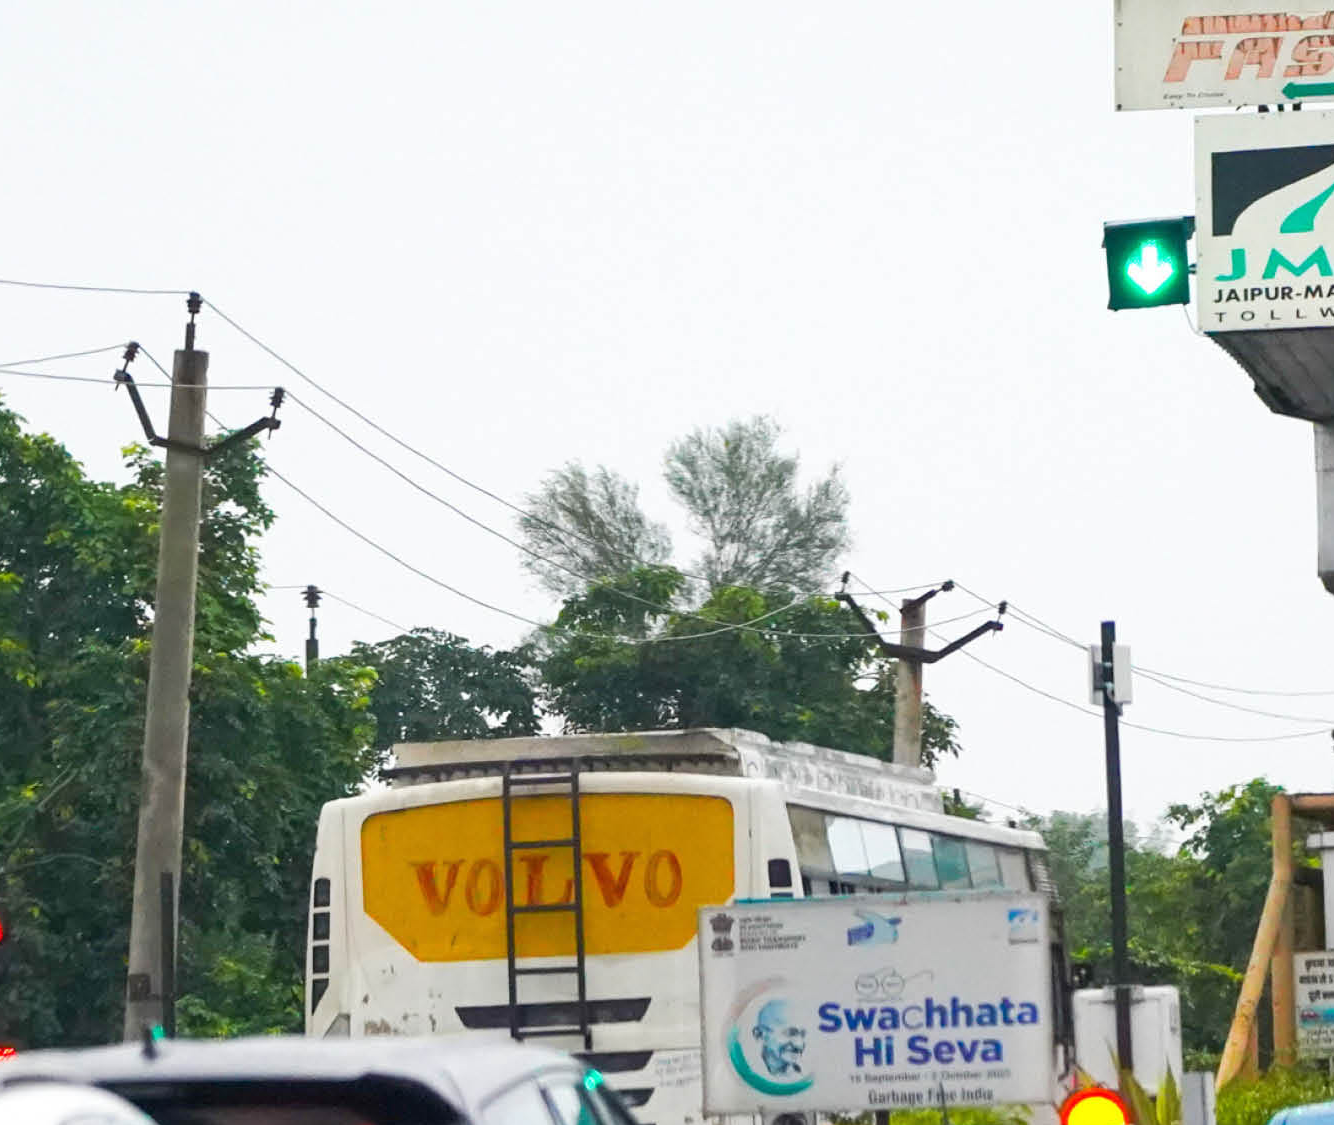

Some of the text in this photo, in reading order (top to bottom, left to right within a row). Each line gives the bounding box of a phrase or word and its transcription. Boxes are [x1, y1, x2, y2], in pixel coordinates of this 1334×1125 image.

[407, 849, 683, 918] VOLVO
[817, 996, 1040, 1034] Swachhata
[854, 1035, 1004, 1067] Hi Seva
[867, 1088, 924, 1106] Garbage
[960, 1085, 995, 1101] India
